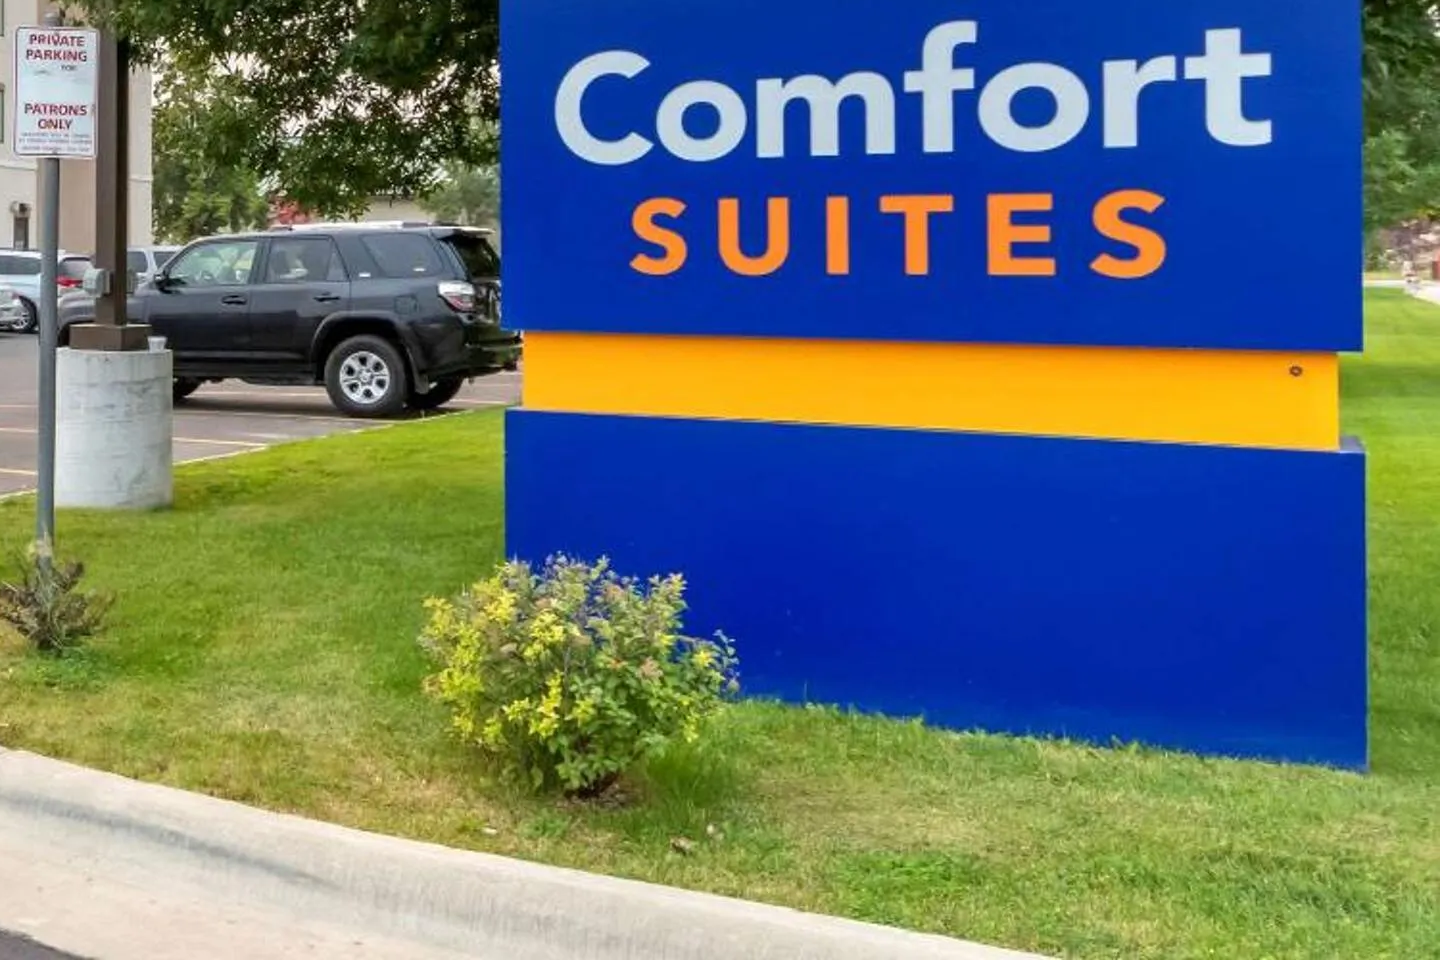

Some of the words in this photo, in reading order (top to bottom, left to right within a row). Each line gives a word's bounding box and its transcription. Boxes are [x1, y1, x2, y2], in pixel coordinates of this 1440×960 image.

[29, 34, 85, 47] PRIVATE
[26, 50, 88, 62] PARKING
[555, 21, 1271, 165] Comfort
[24, 103, 88, 116] PATRONS
[37, 118, 73, 129] ONLY
[631, 189, 1166, 279] SUITES
